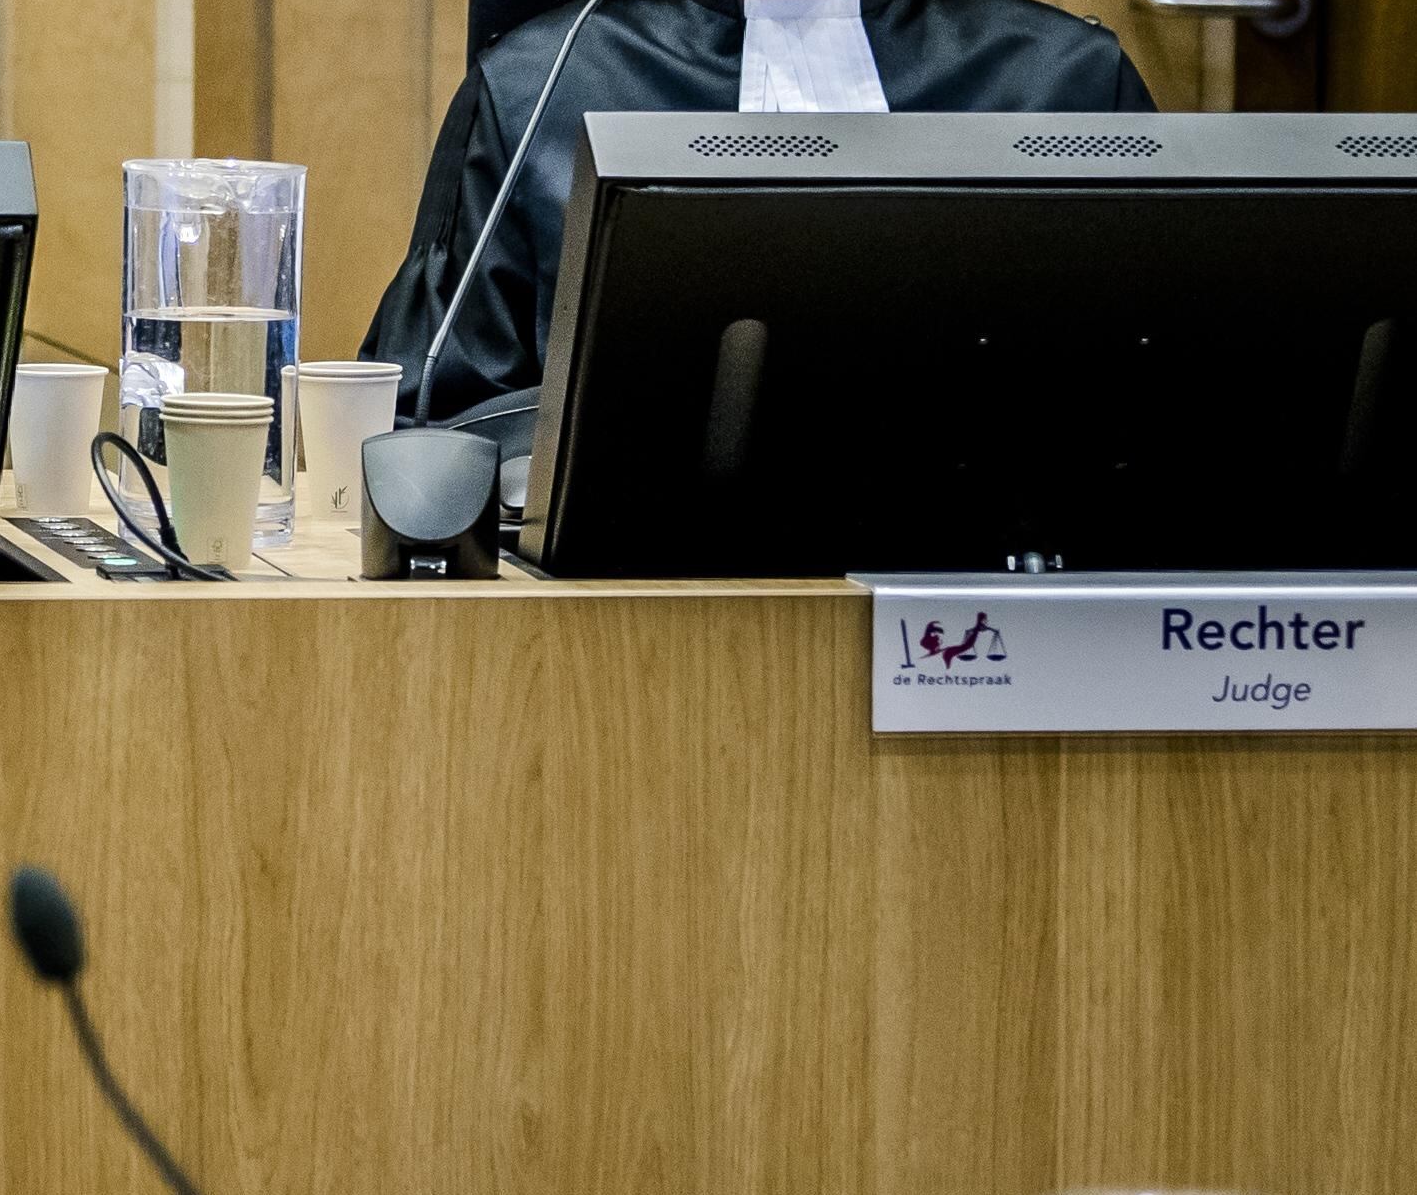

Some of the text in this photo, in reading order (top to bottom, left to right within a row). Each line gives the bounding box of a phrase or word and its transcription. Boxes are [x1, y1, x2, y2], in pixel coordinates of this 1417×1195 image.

[1161, 604, 1366, 651] Rechter
[892, 672, 1012, 688] de Rechtspraak
[1210, 672, 1313, 711] Judge
